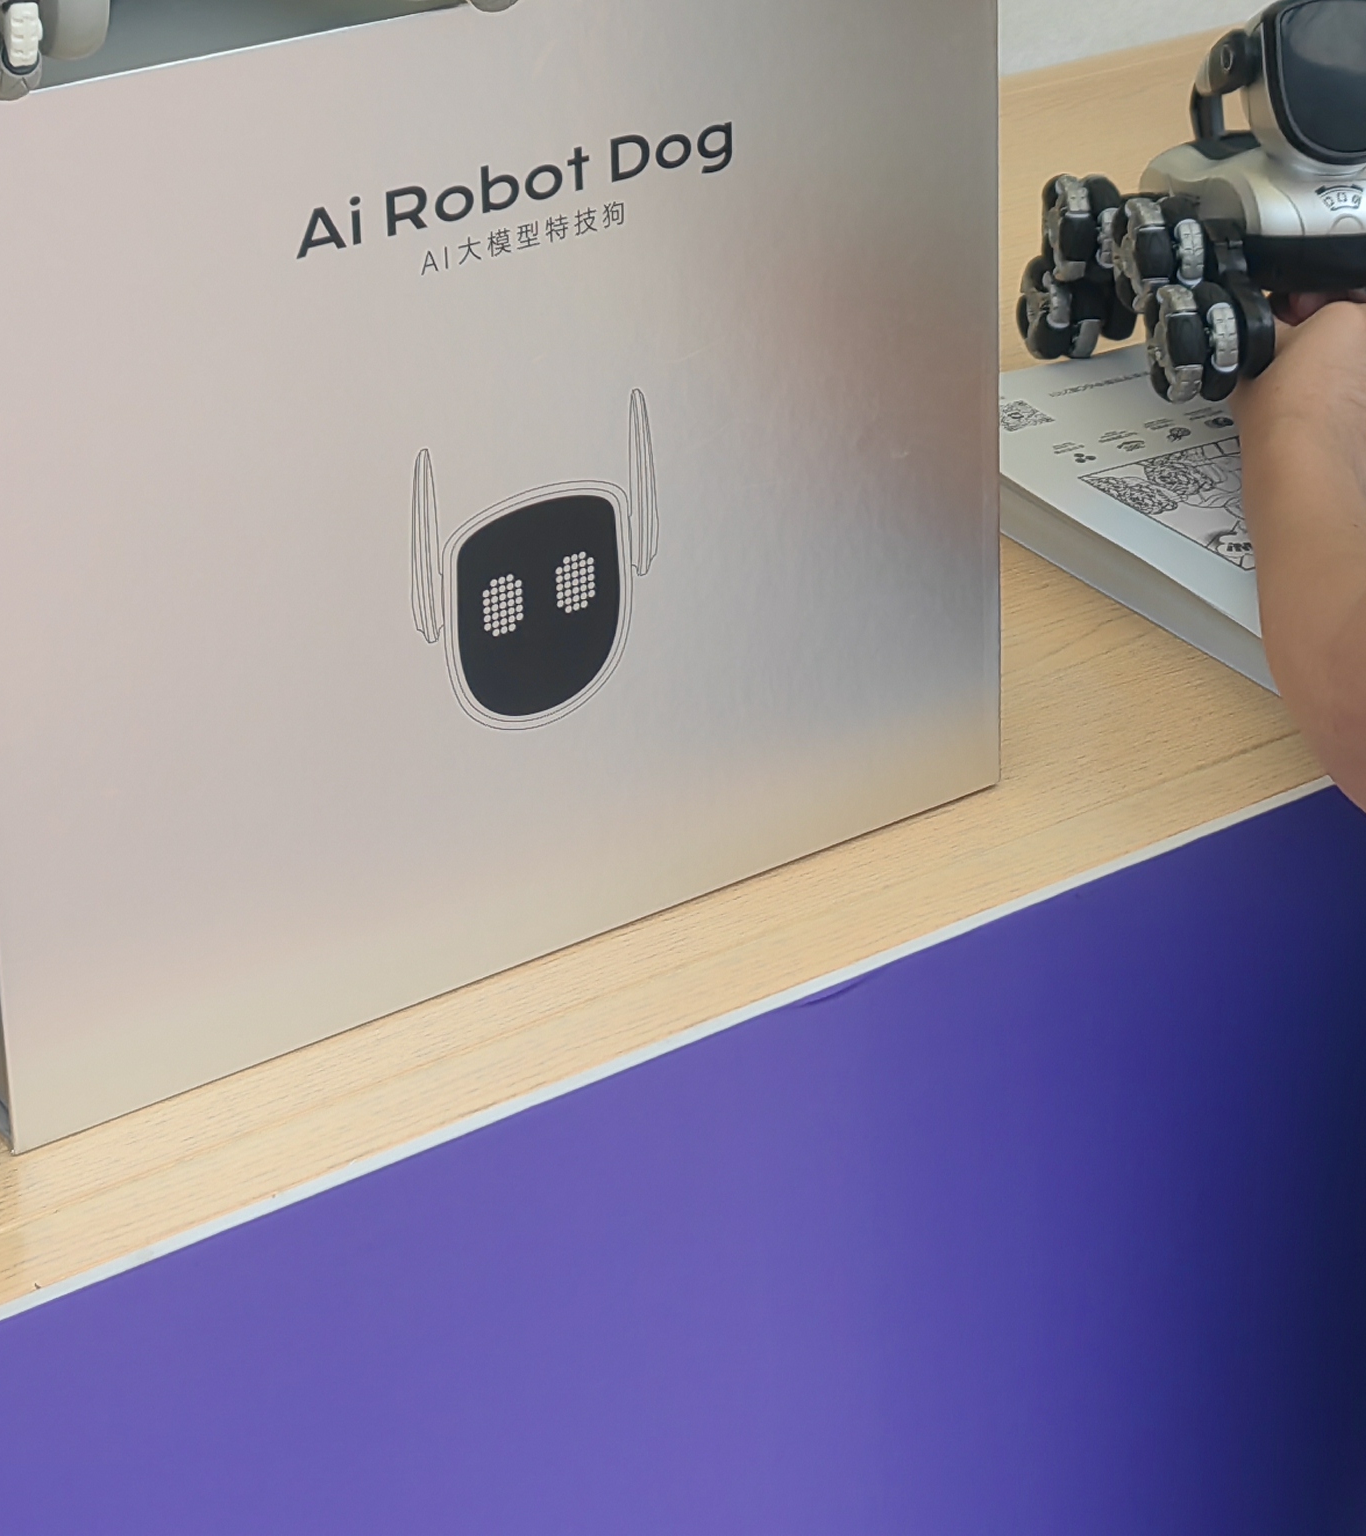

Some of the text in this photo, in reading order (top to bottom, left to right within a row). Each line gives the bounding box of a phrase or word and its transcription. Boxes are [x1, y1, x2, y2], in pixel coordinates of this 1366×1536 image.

[297, 121, 733, 260] Ai Robot Dog
[421, 200, 626, 277] AI大模型特技狗
